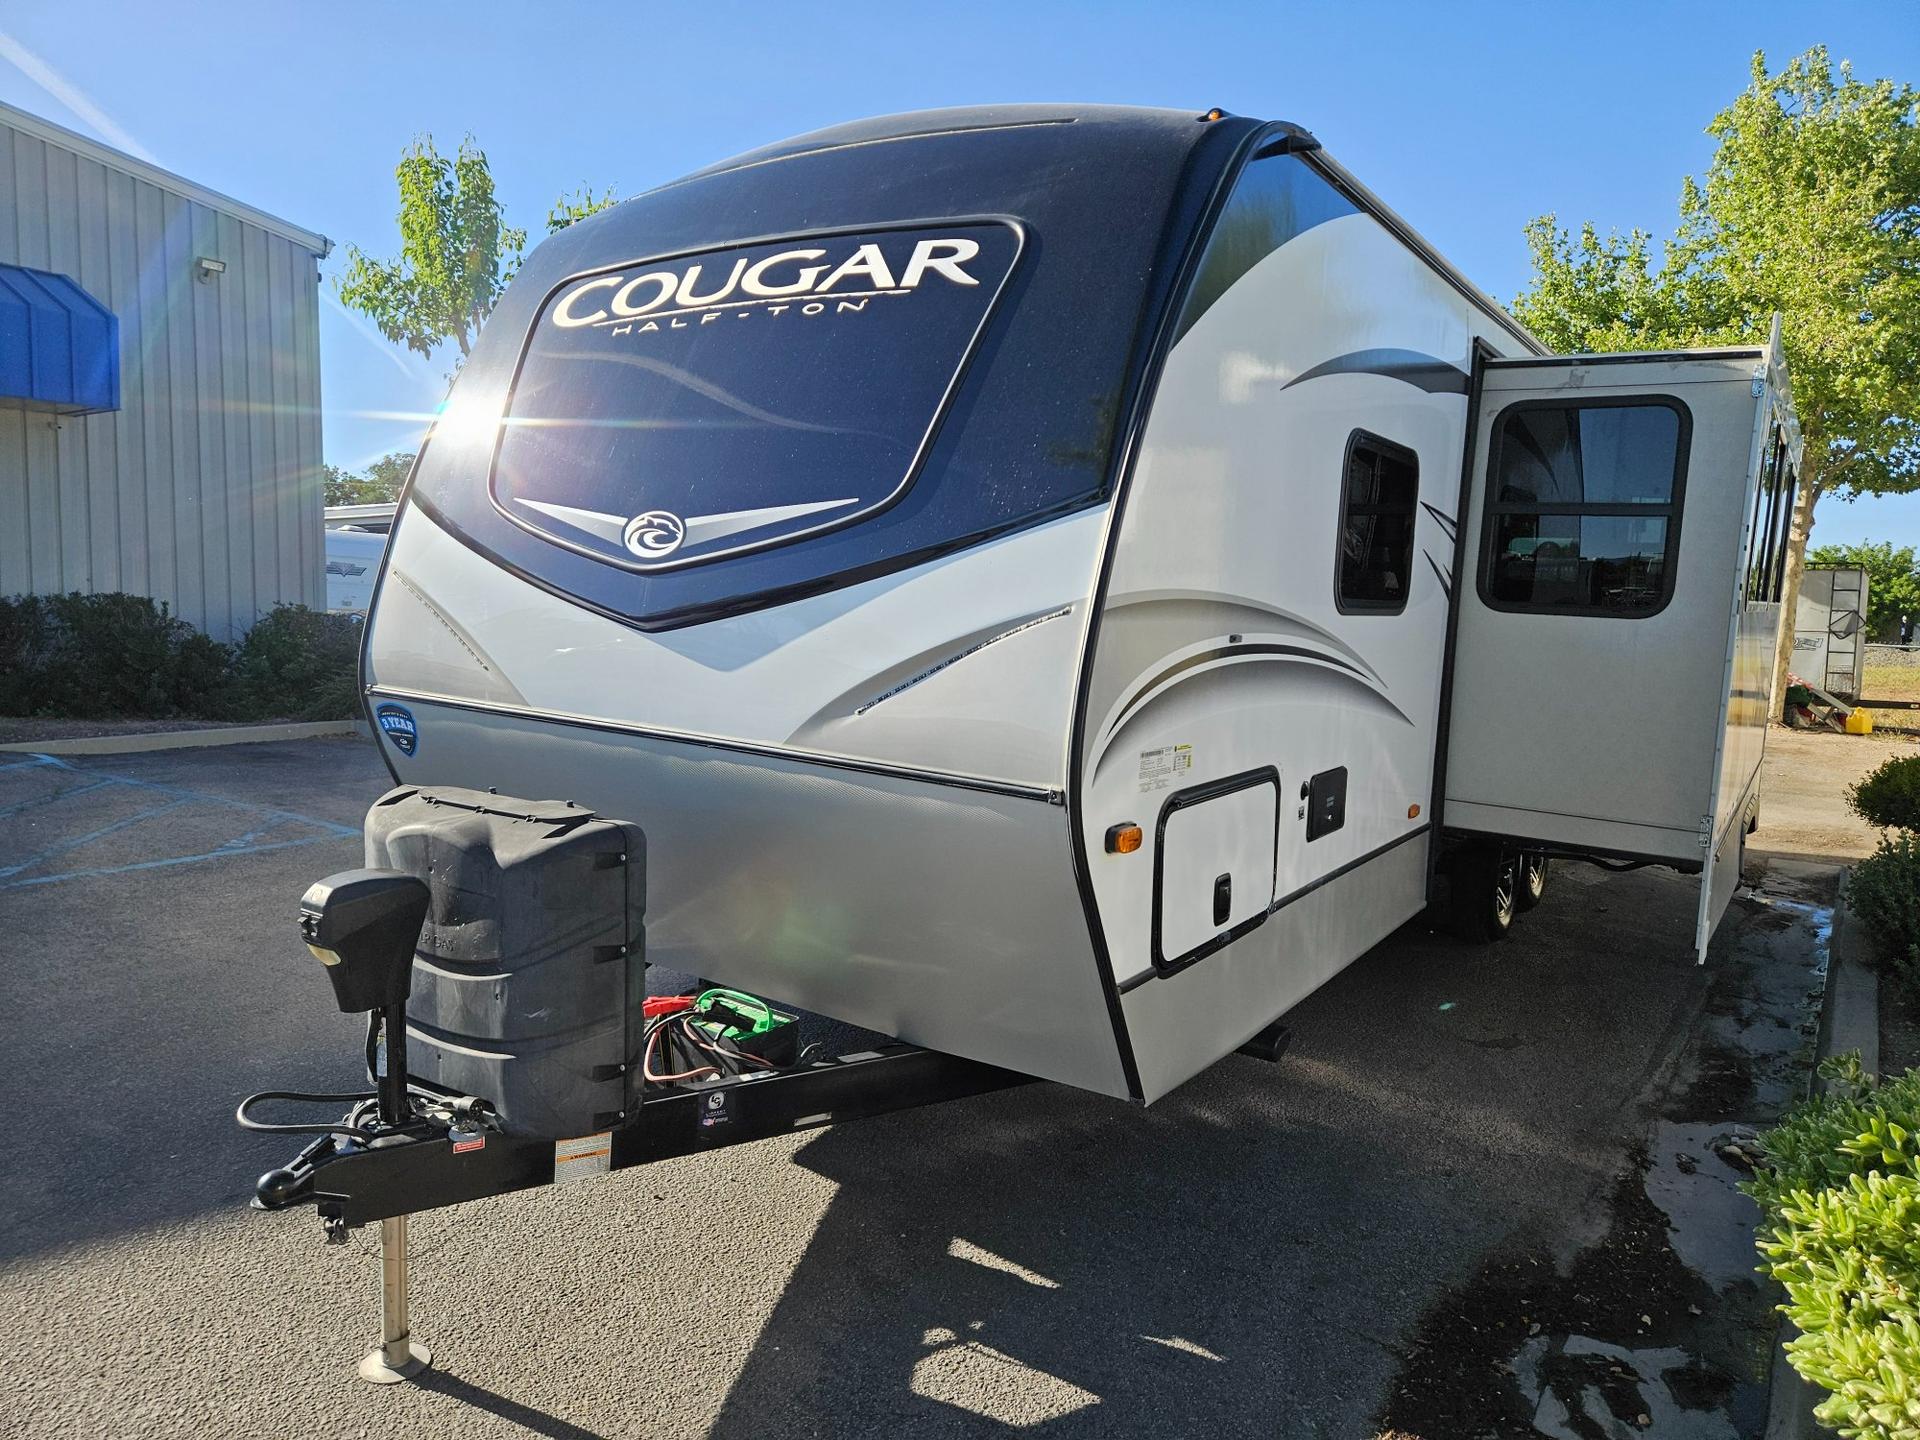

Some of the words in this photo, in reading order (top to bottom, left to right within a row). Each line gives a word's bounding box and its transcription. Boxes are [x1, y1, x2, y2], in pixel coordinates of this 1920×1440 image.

[552, 238, 981, 328] COUGAR
[612, 298, 870, 337] HALF-TON
[381, 718, 390, 729] 3
[387, 716, 414, 733] YEAR
